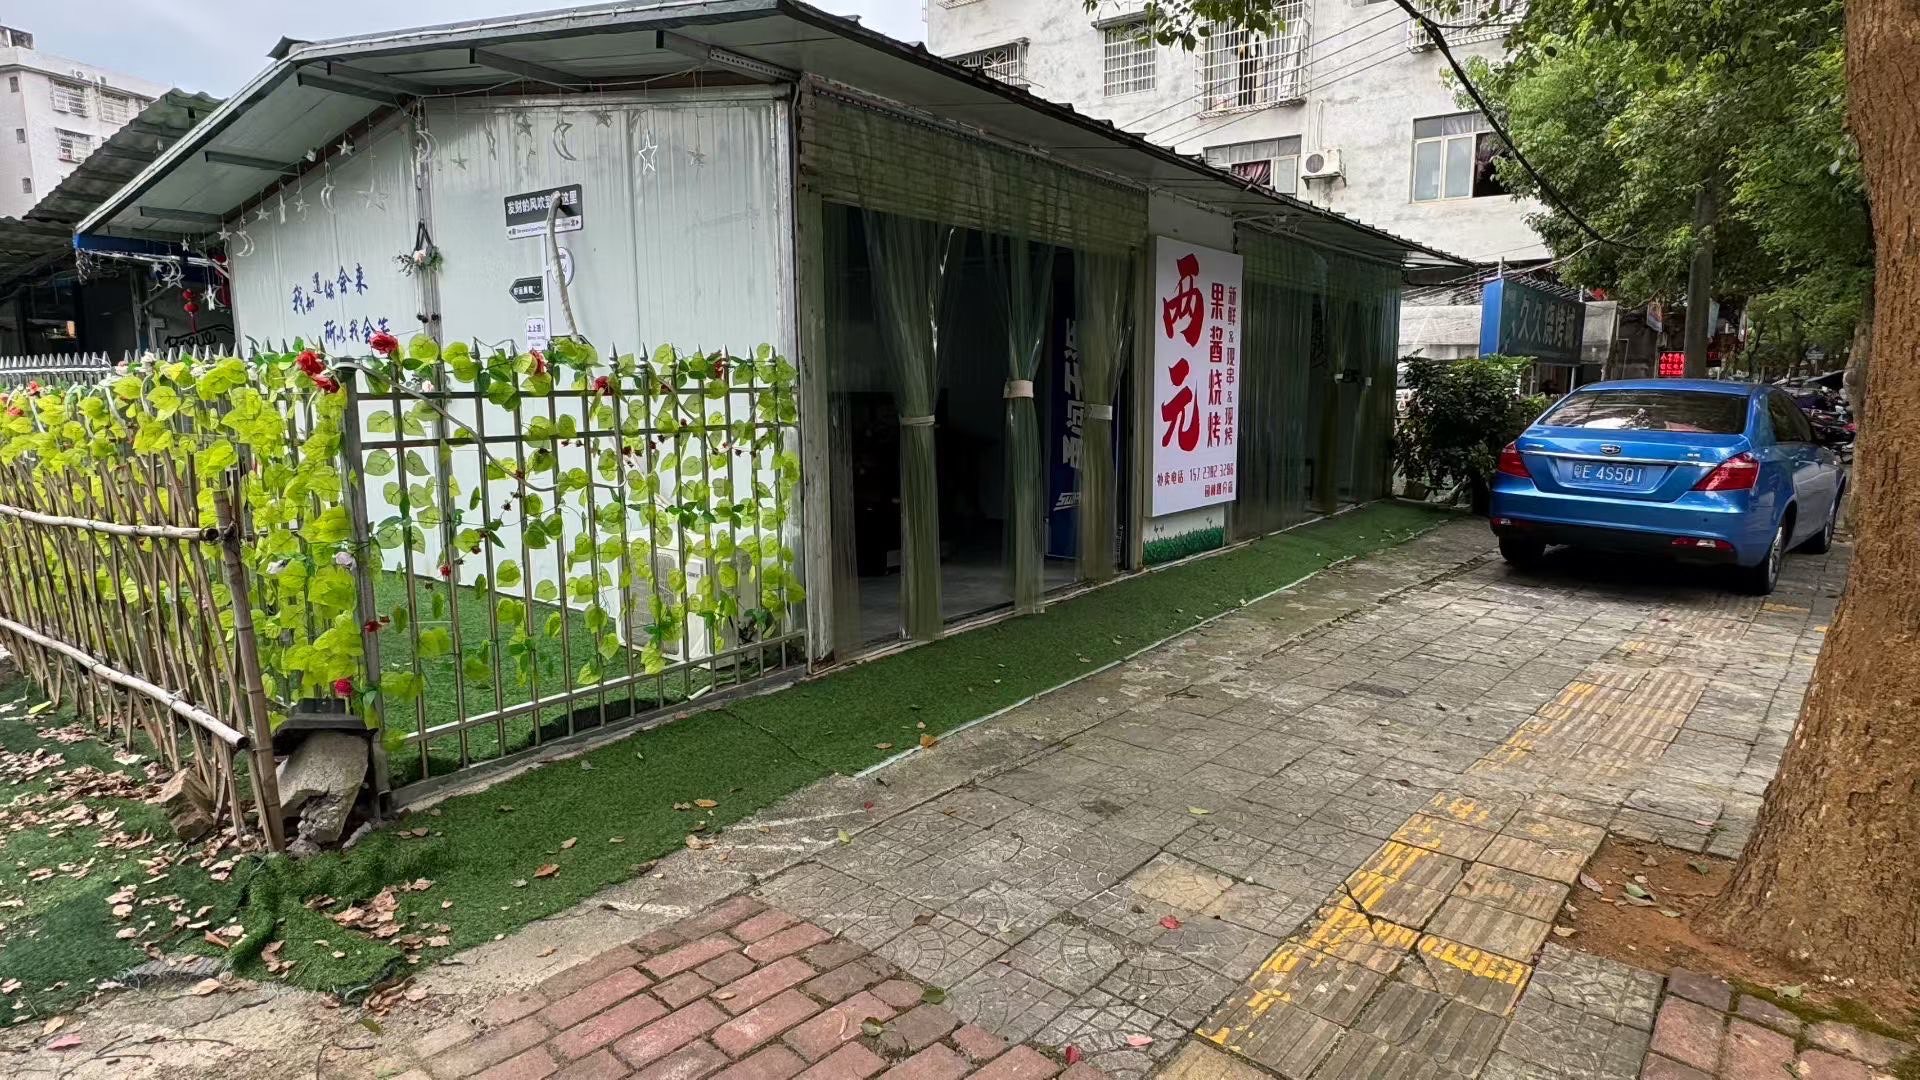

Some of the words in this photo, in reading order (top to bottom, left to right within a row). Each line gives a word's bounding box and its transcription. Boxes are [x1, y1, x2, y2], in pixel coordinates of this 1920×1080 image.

[507, 190, 577, 215] 发财的风吹到这里
[1162, 253, 1204, 452] 两元
[1207, 282, 1224, 448] 果酱烧烤
